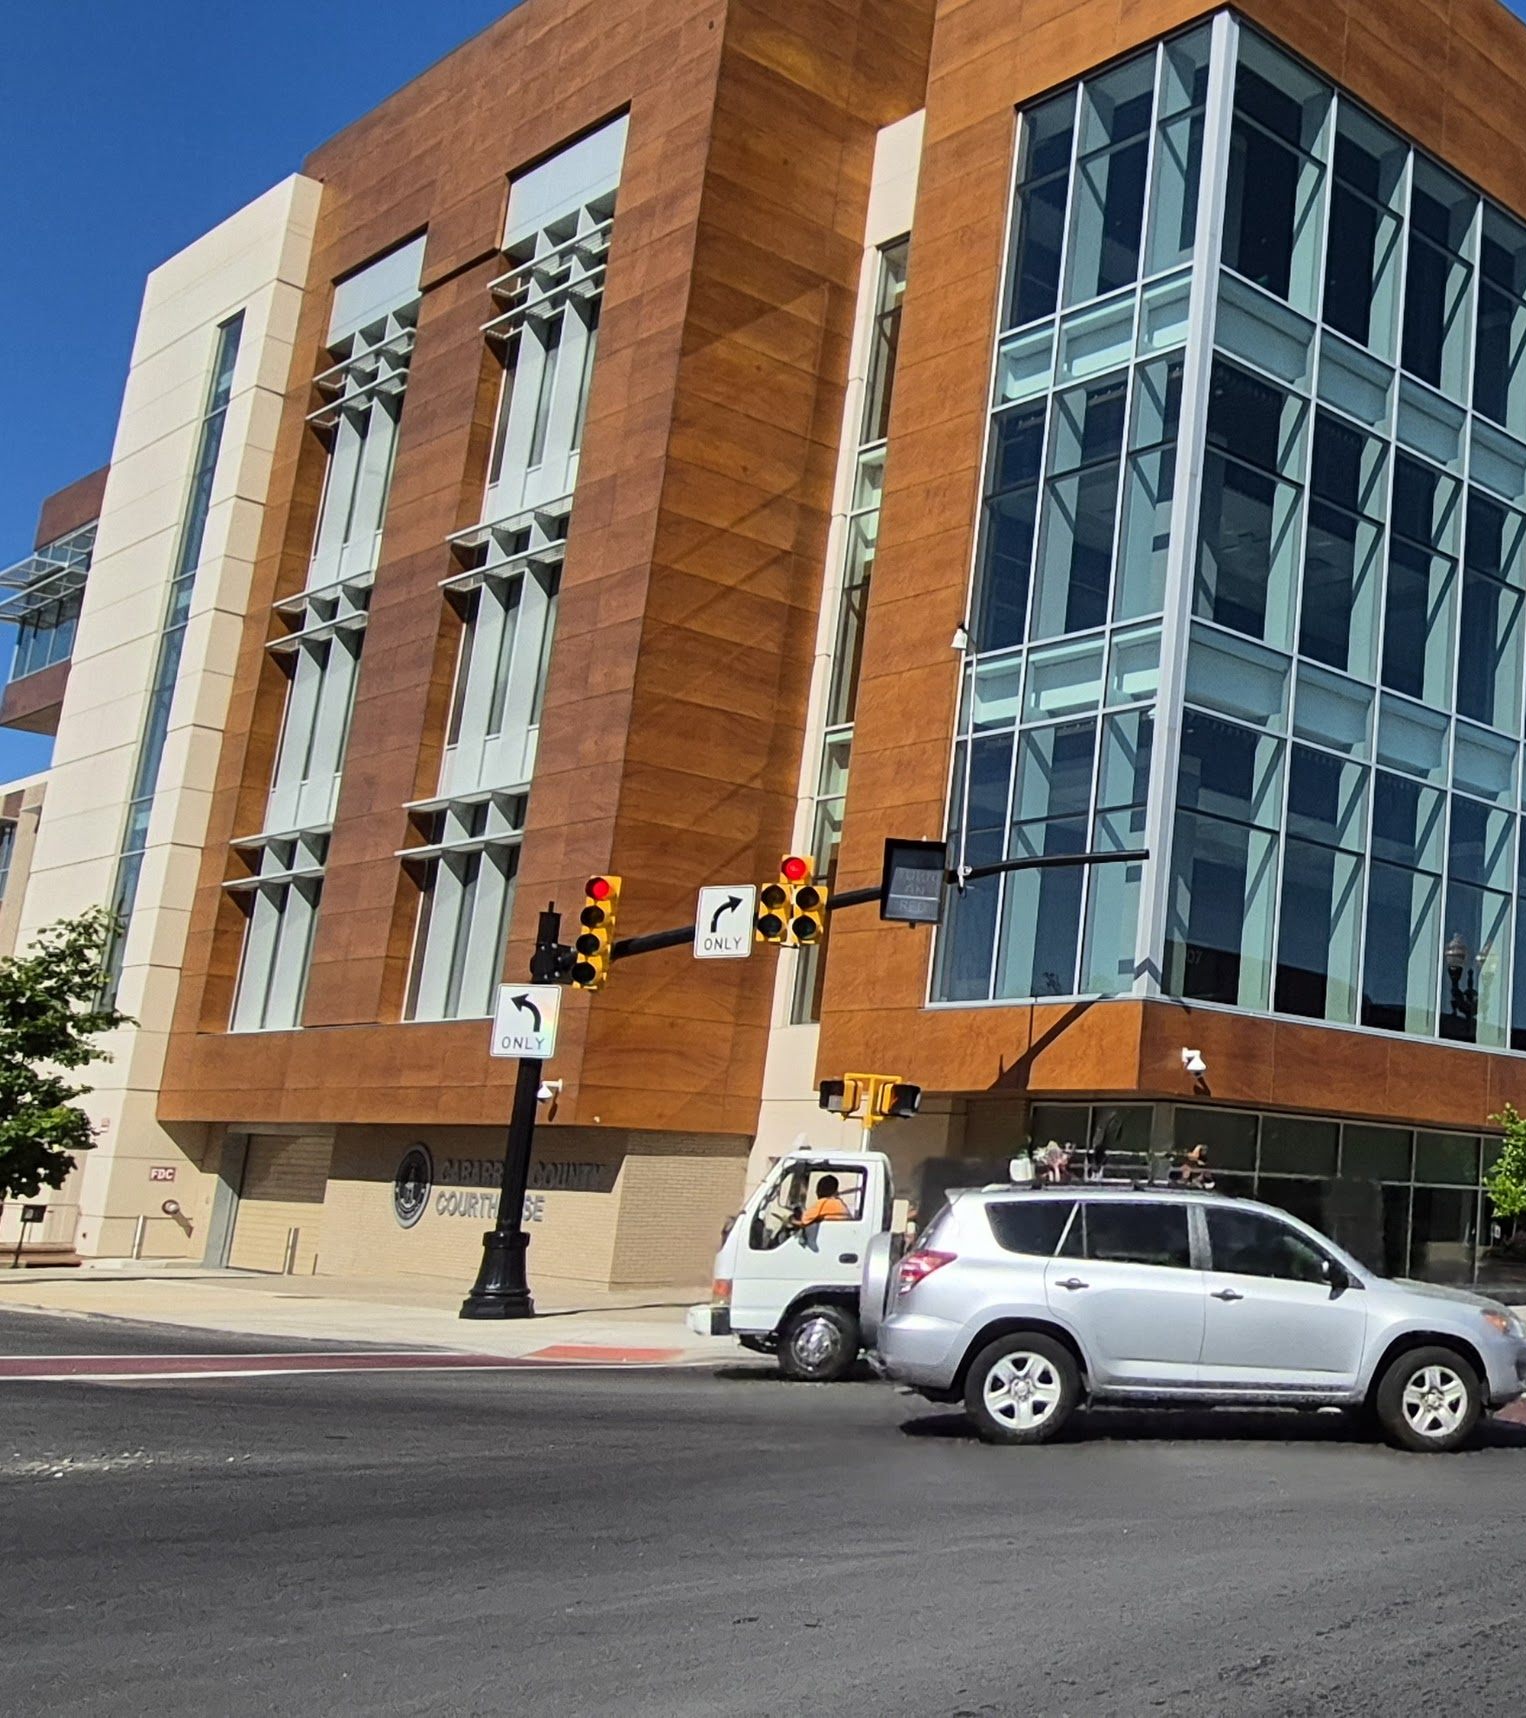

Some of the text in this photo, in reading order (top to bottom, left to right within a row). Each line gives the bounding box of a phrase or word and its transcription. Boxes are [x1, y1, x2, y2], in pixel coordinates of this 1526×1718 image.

[703, 936, 742, 951] ONLY
[501, 1036, 545, 1050] ONLY
[150, 1168, 175, 1180] FDC
[435, 1190, 546, 1223] COURTHSE
